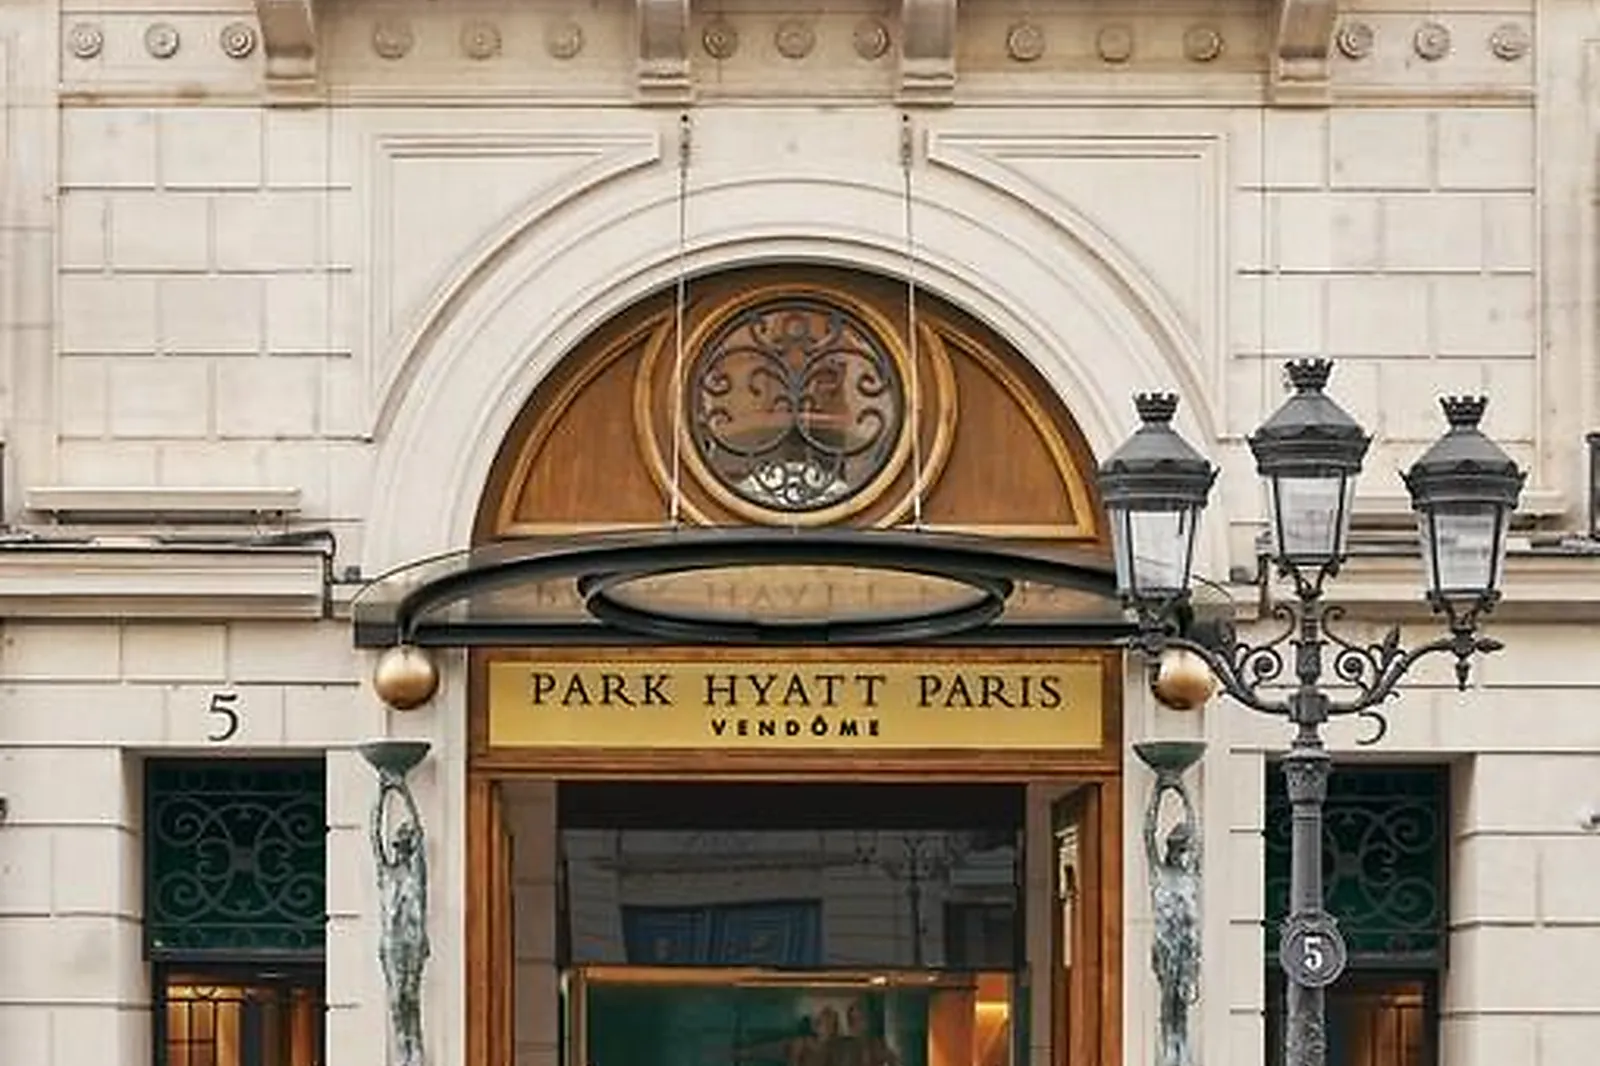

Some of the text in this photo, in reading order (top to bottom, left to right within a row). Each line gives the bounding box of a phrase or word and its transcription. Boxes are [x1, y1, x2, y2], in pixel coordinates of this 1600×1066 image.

[531, 673, 1063, 709] PARK HYATT PARIS
[209, 694, 238, 741] 5
[711, 714, 880, 737] VENDÔME
[1304, 936, 1323, 971] 5
